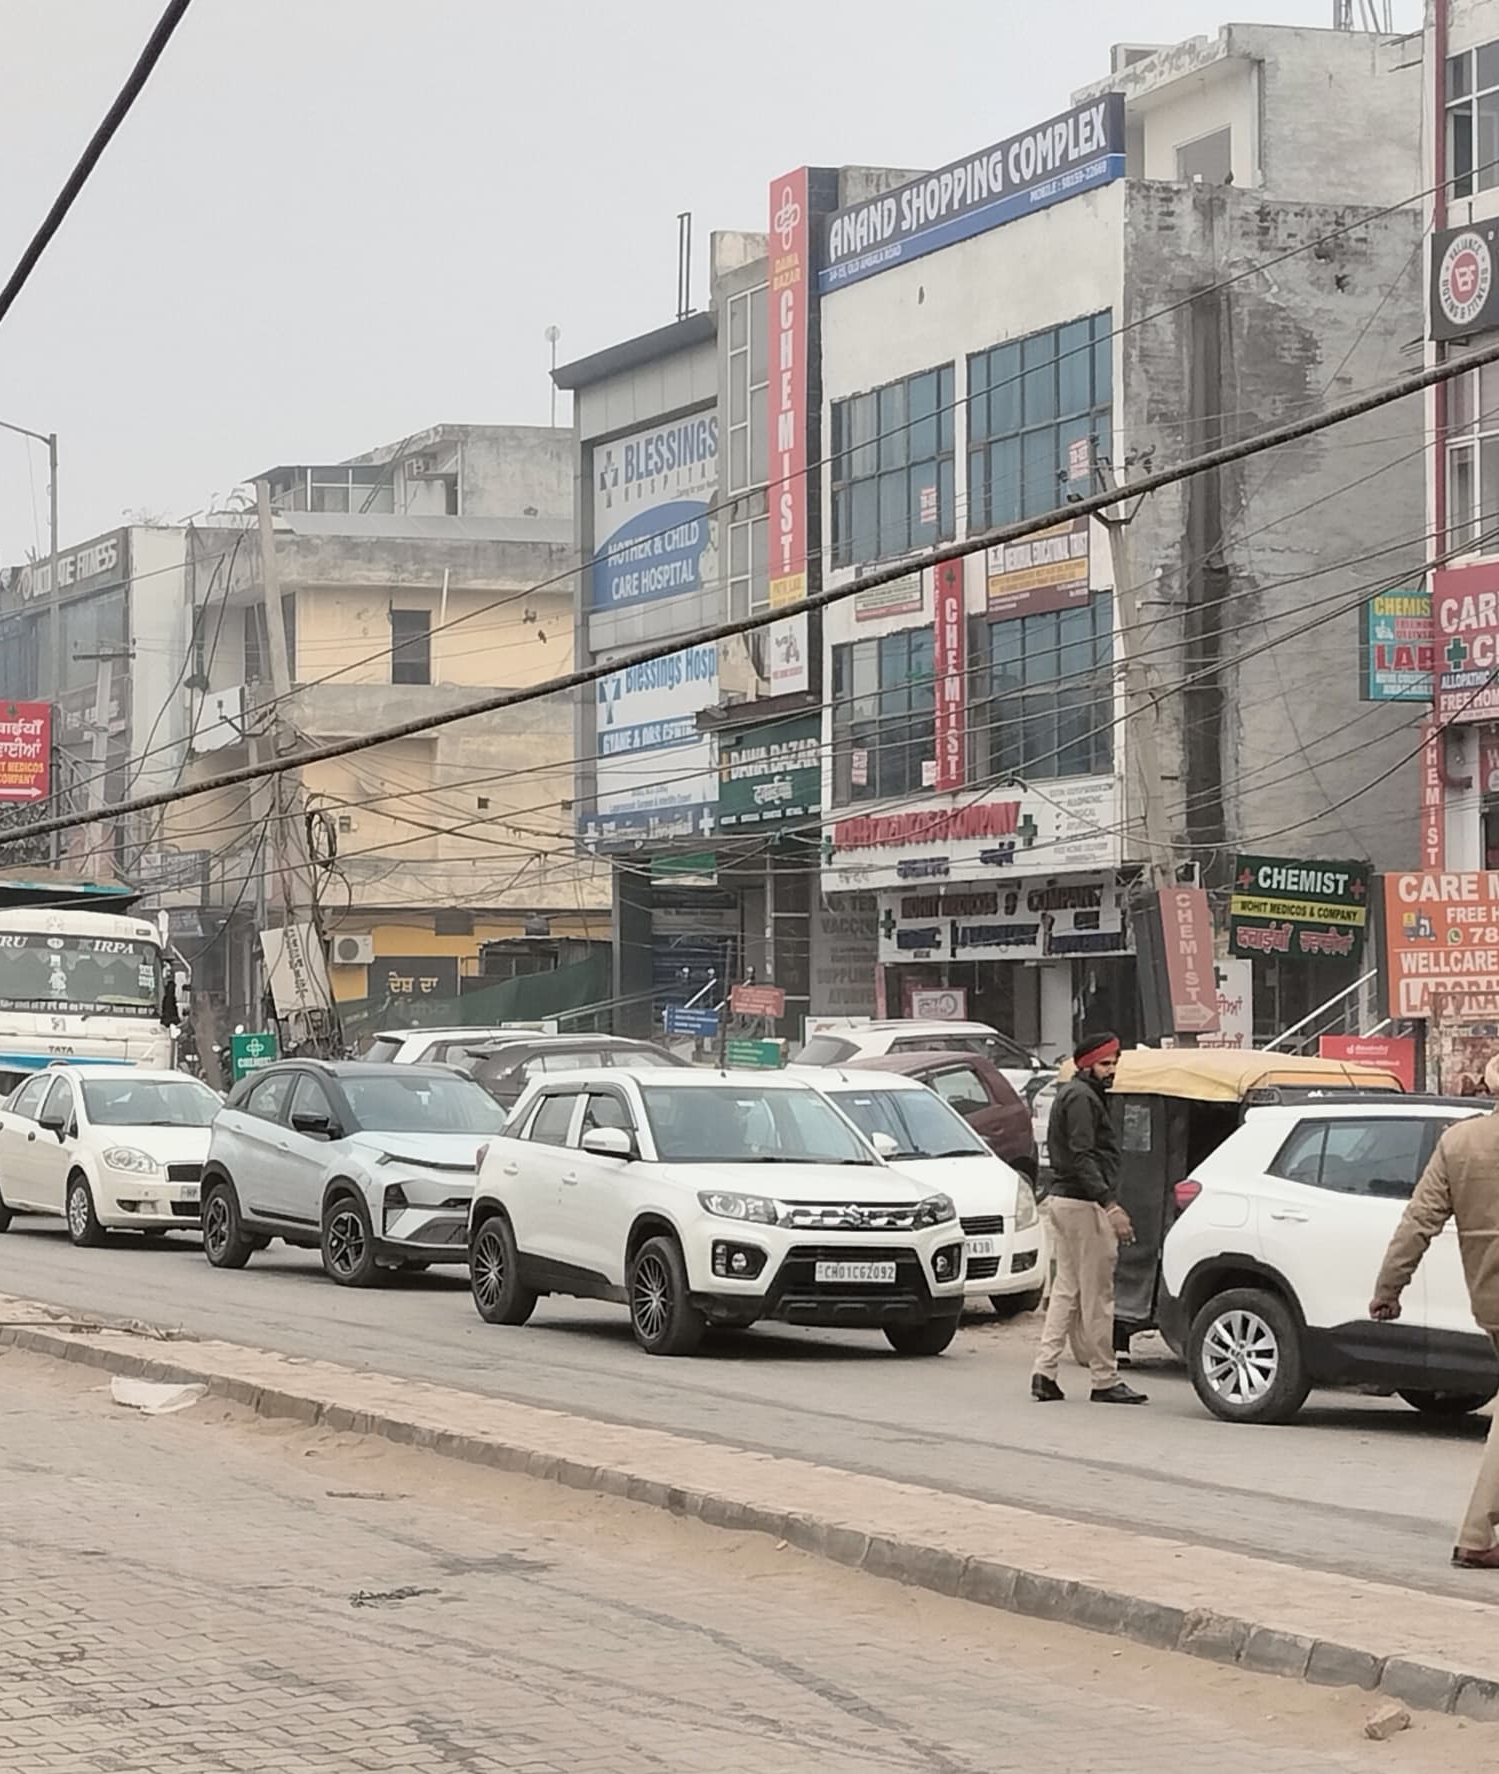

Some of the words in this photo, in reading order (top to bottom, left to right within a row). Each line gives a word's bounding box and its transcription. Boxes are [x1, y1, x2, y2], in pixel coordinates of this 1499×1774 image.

[829, 197, 897, 264] ANAND
[900, 151, 1003, 232] SHOPPING
[1007, 102, 1107, 184] COMPLEX
[773, 268, 801, 291] BAZAR
[625, 416, 718, 485] BLESSINGS
[608, 537, 652, 568] MOTHER
[654, 537, 663, 552] &
[664, 520, 700, 552] CHILD
[77, 538, 118, 581] FITNESS
[612, 572, 639, 601] CARE
[641, 559, 695, 591] HOSPITAL
[1440, 592, 1499, 633] CAR
[626, 655, 682, 694] Blessings
[685, 647, 716, 687] Hosp
[1441, 671, 1490, 690] ALLOPATHIC
[1440, 692, 1471, 711] FREE
[731, 746, 770, 780] DAWA
[770, 738, 820, 774] BAZAR
[1425, 727, 1440, 865] CHEMIST
[1258, 866, 1348, 895] CHEMIST
[1399, 874, 1480, 903] CARE
[1240, 900, 1268, 912] MOHIT
[1270, 901, 1307, 917] MEDICOS
[1309, 906, 1315, 917] &
[1317, 907, 1358, 921] COMPANY
[1446, 907, 1488, 924] FREE
[78, 938, 135, 955] KIRPA
[1176, 893, 1200, 1002] CHEMIST
[1469, 928, 1499, 944] 78
[1401, 951, 1498, 974] WELLCARE
[419, 976, 439, 993] ਦਾ
[48, 1045, 74, 1054] TATA
